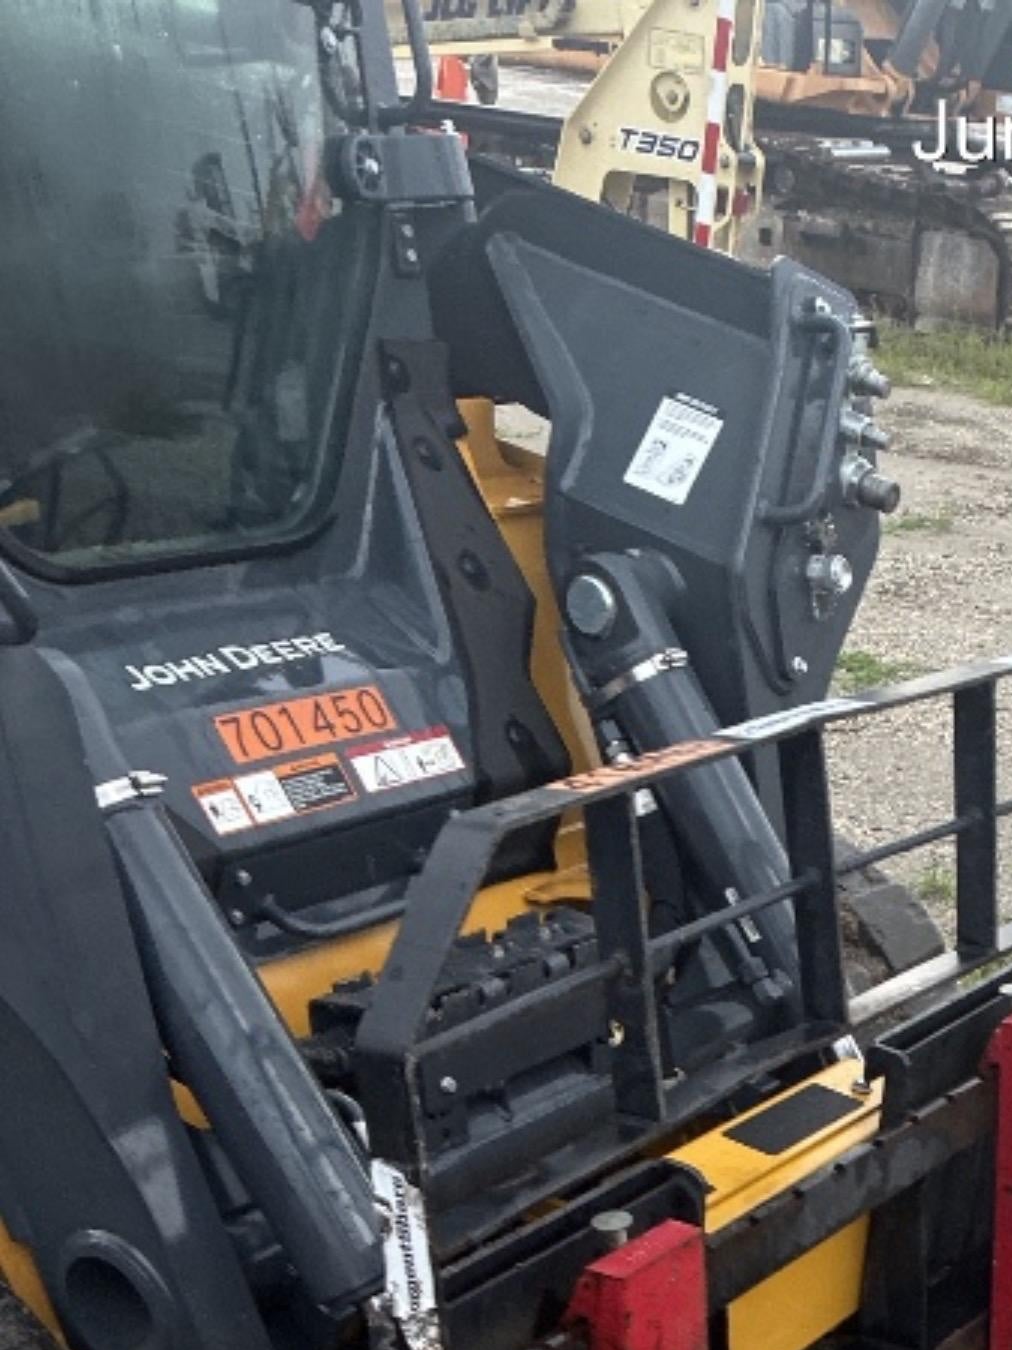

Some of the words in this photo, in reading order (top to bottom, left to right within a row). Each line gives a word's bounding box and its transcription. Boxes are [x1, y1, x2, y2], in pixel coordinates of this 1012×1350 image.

[619, 127, 700, 162] T350
[124, 652, 232, 692] JOHN
[217, 630, 346, 671] DEERE
[218, 688, 390, 758] 701450
